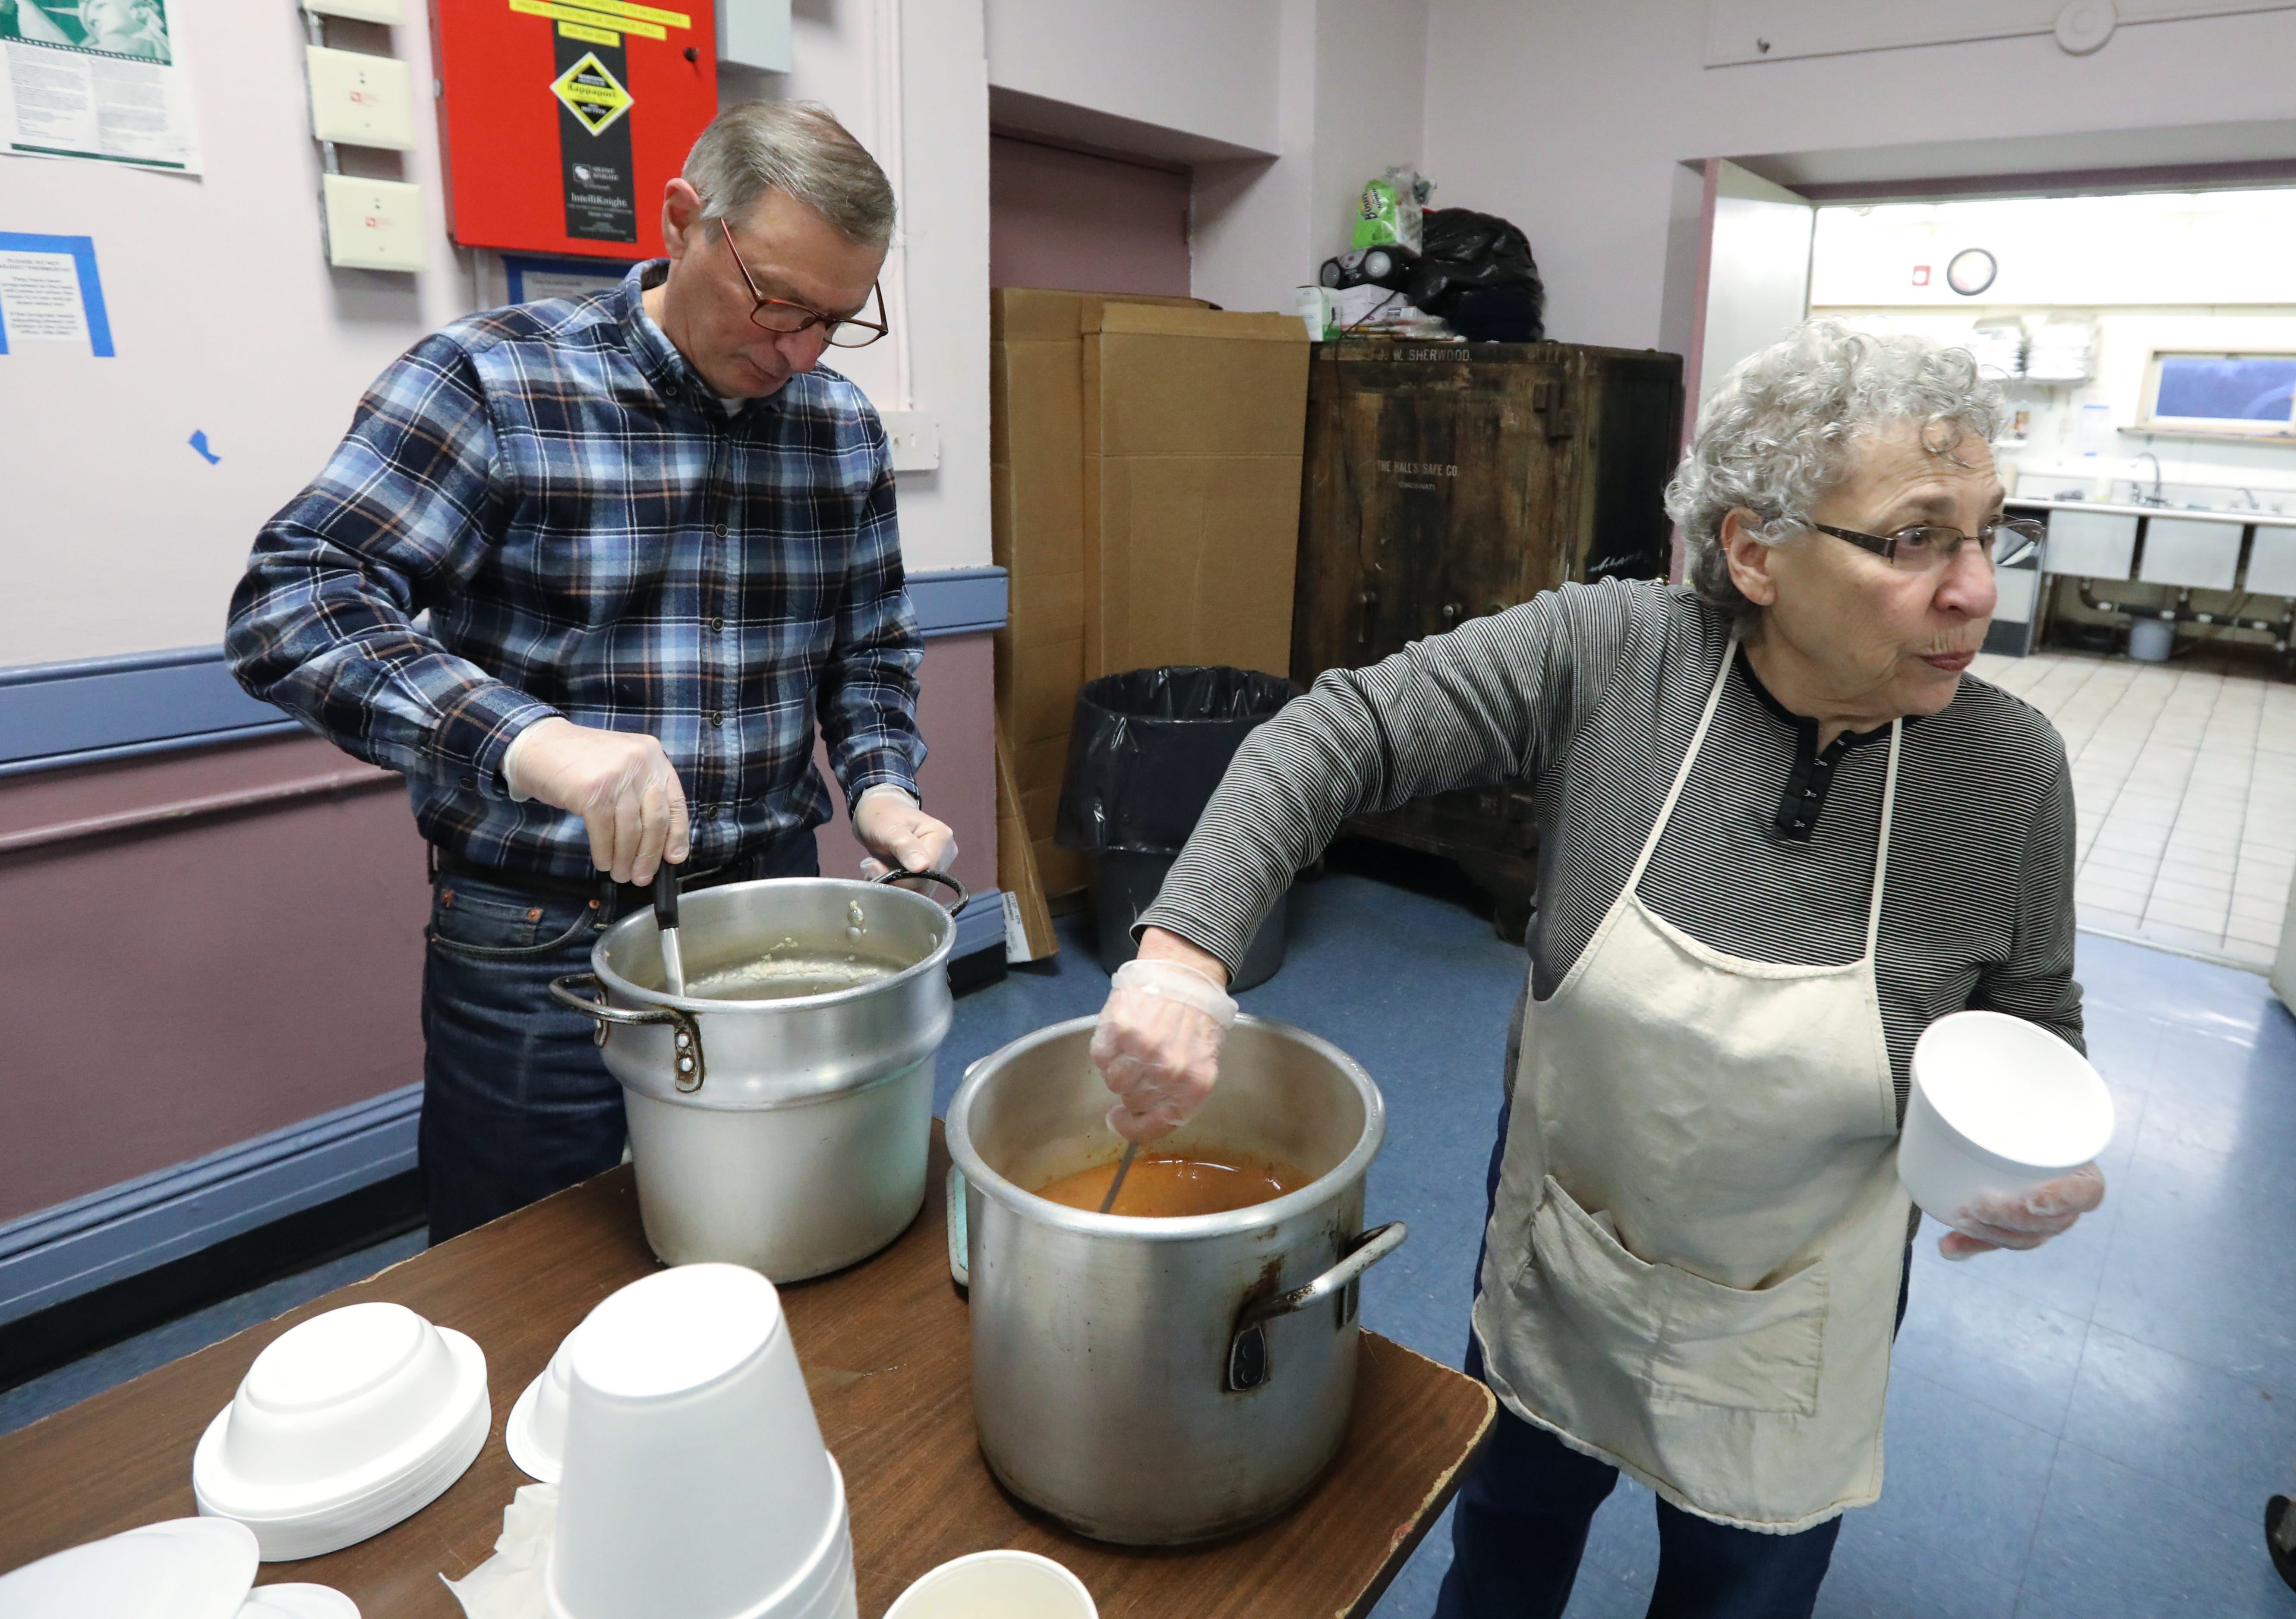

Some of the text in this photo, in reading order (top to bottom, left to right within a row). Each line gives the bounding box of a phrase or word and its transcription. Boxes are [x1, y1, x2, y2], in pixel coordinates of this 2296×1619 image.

[1409, 349, 1473, 362] SHERWOOD.
[1378, 460, 1391, 472] THE
[1422, 463, 1443, 476] SAFE
